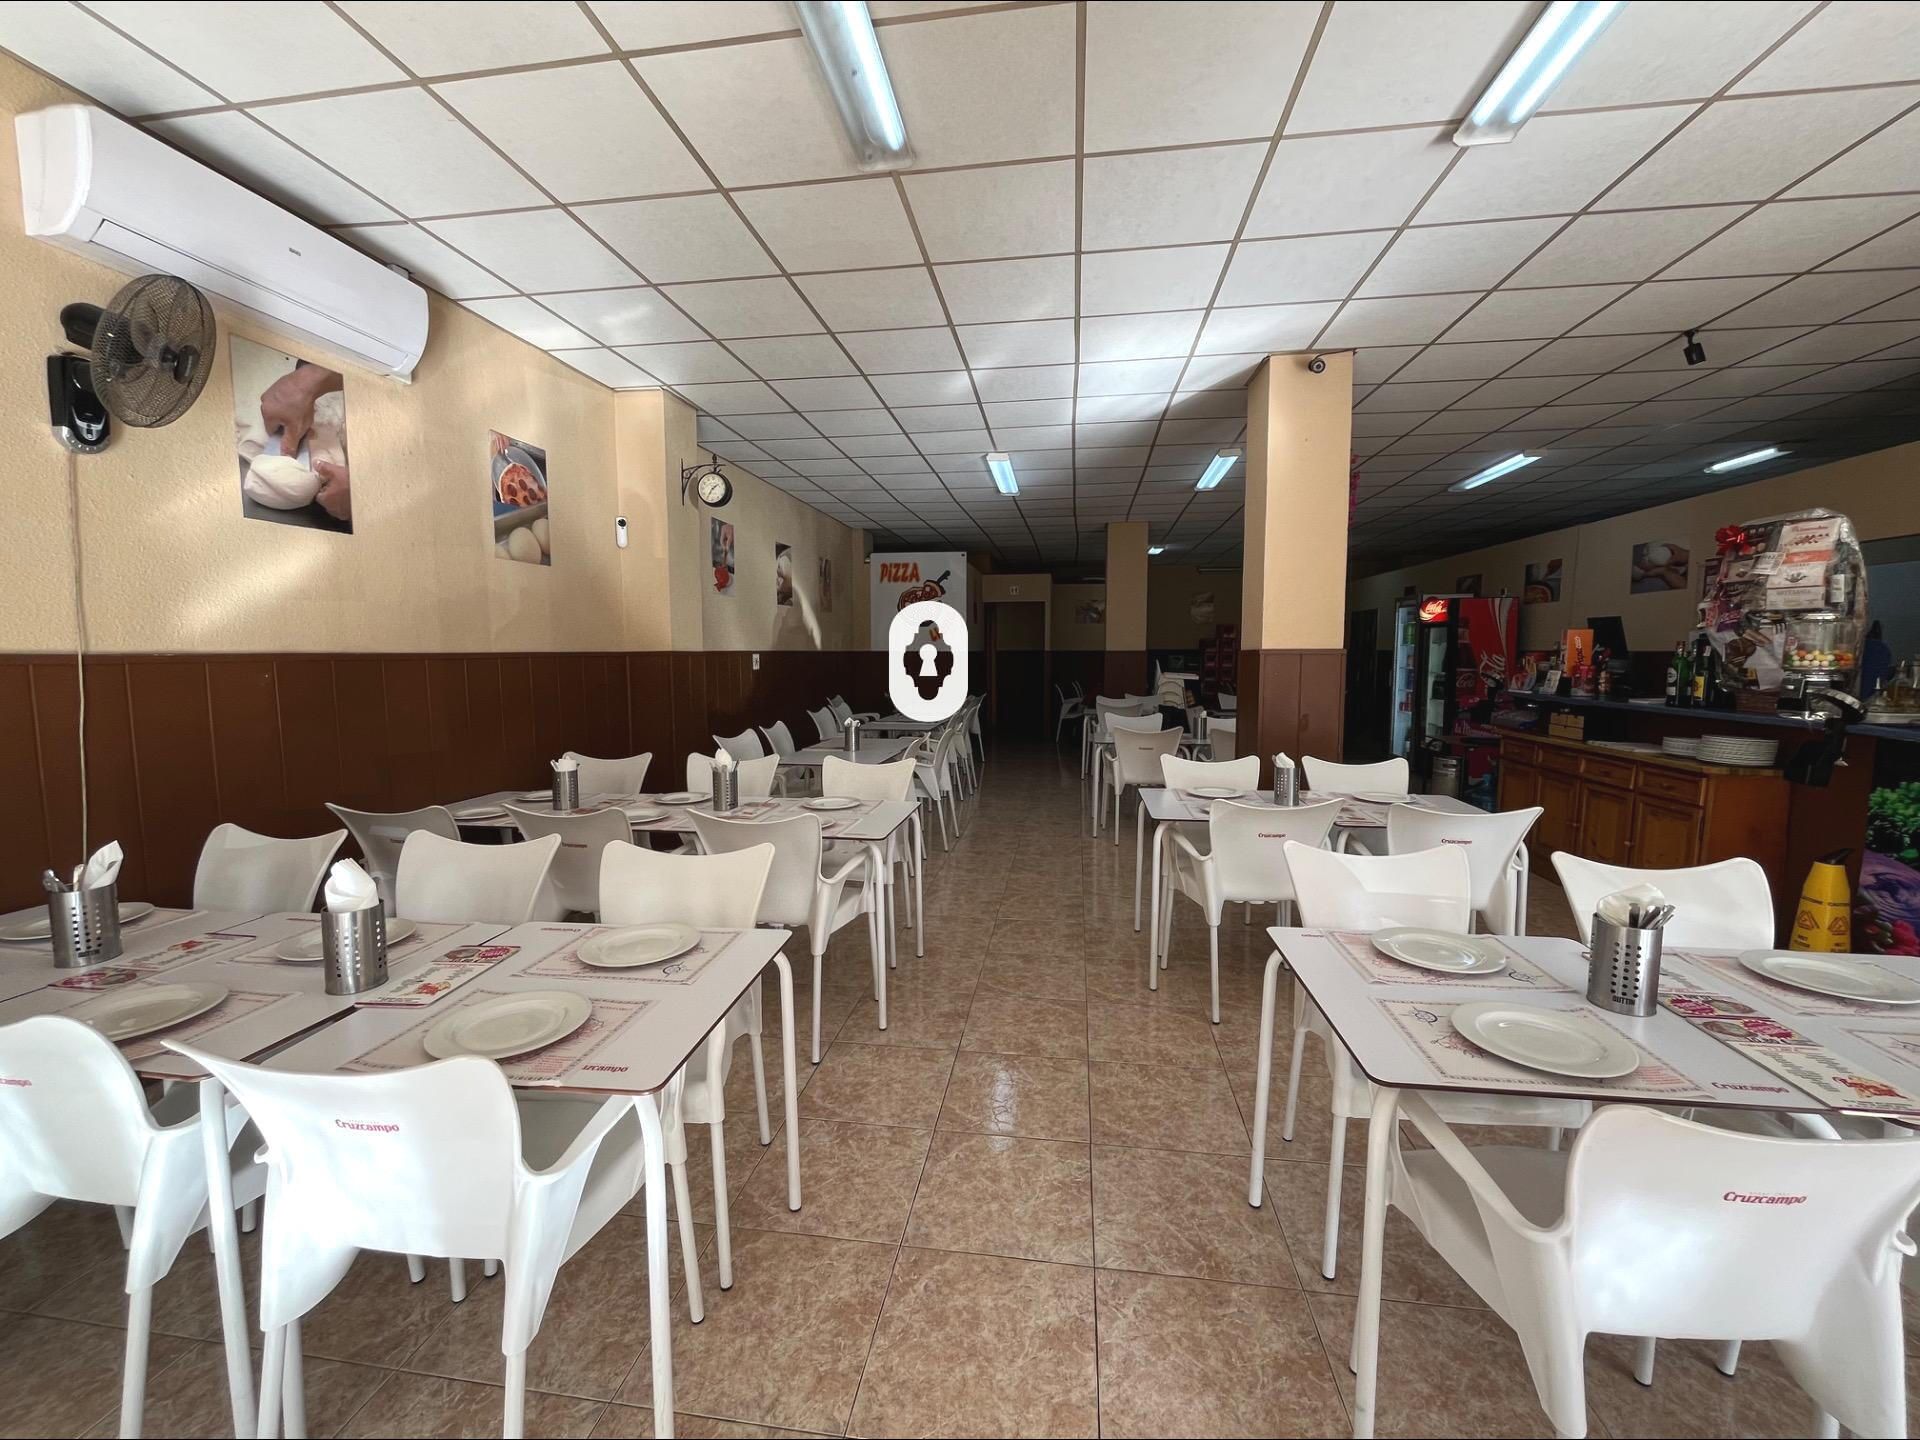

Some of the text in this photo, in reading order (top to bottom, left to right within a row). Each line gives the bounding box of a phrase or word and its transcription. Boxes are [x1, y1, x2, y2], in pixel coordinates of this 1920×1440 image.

[880, 562, 920, 583] PIZZA
[1711, 1081, 1791, 1094] Cruzcampo
[334, 1118, 400, 1134] Cruzcampo
[1722, 1190, 1808, 1206] Cruzcampo
